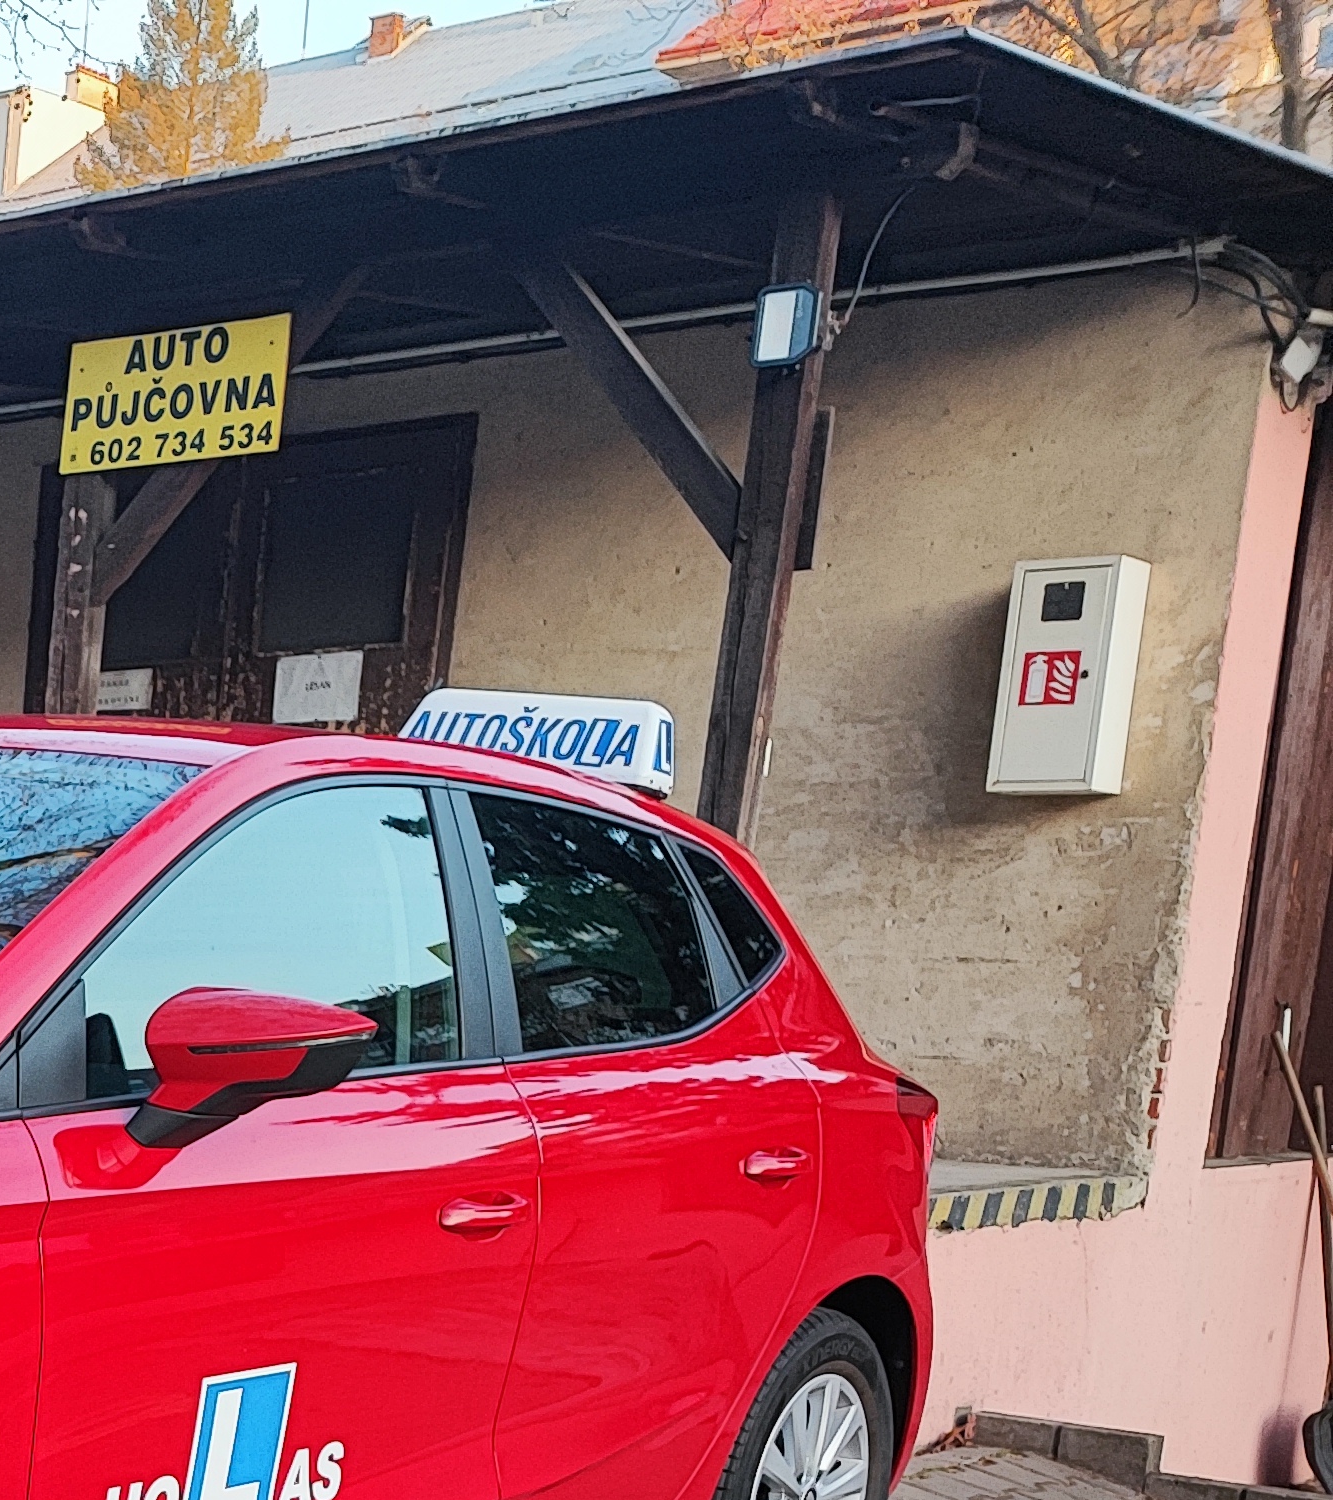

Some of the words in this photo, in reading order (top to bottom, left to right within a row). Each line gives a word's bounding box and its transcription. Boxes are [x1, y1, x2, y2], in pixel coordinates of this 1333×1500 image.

[124, 326, 229, 374] AUTO
[70, 373, 275, 432] PŮJČOVNA
[91, 436, 142, 465] 602
[155, 428, 205, 458] 734
[219, 420, 273, 451] 534
[408, 706, 640, 768] AUTOŠKOLA
